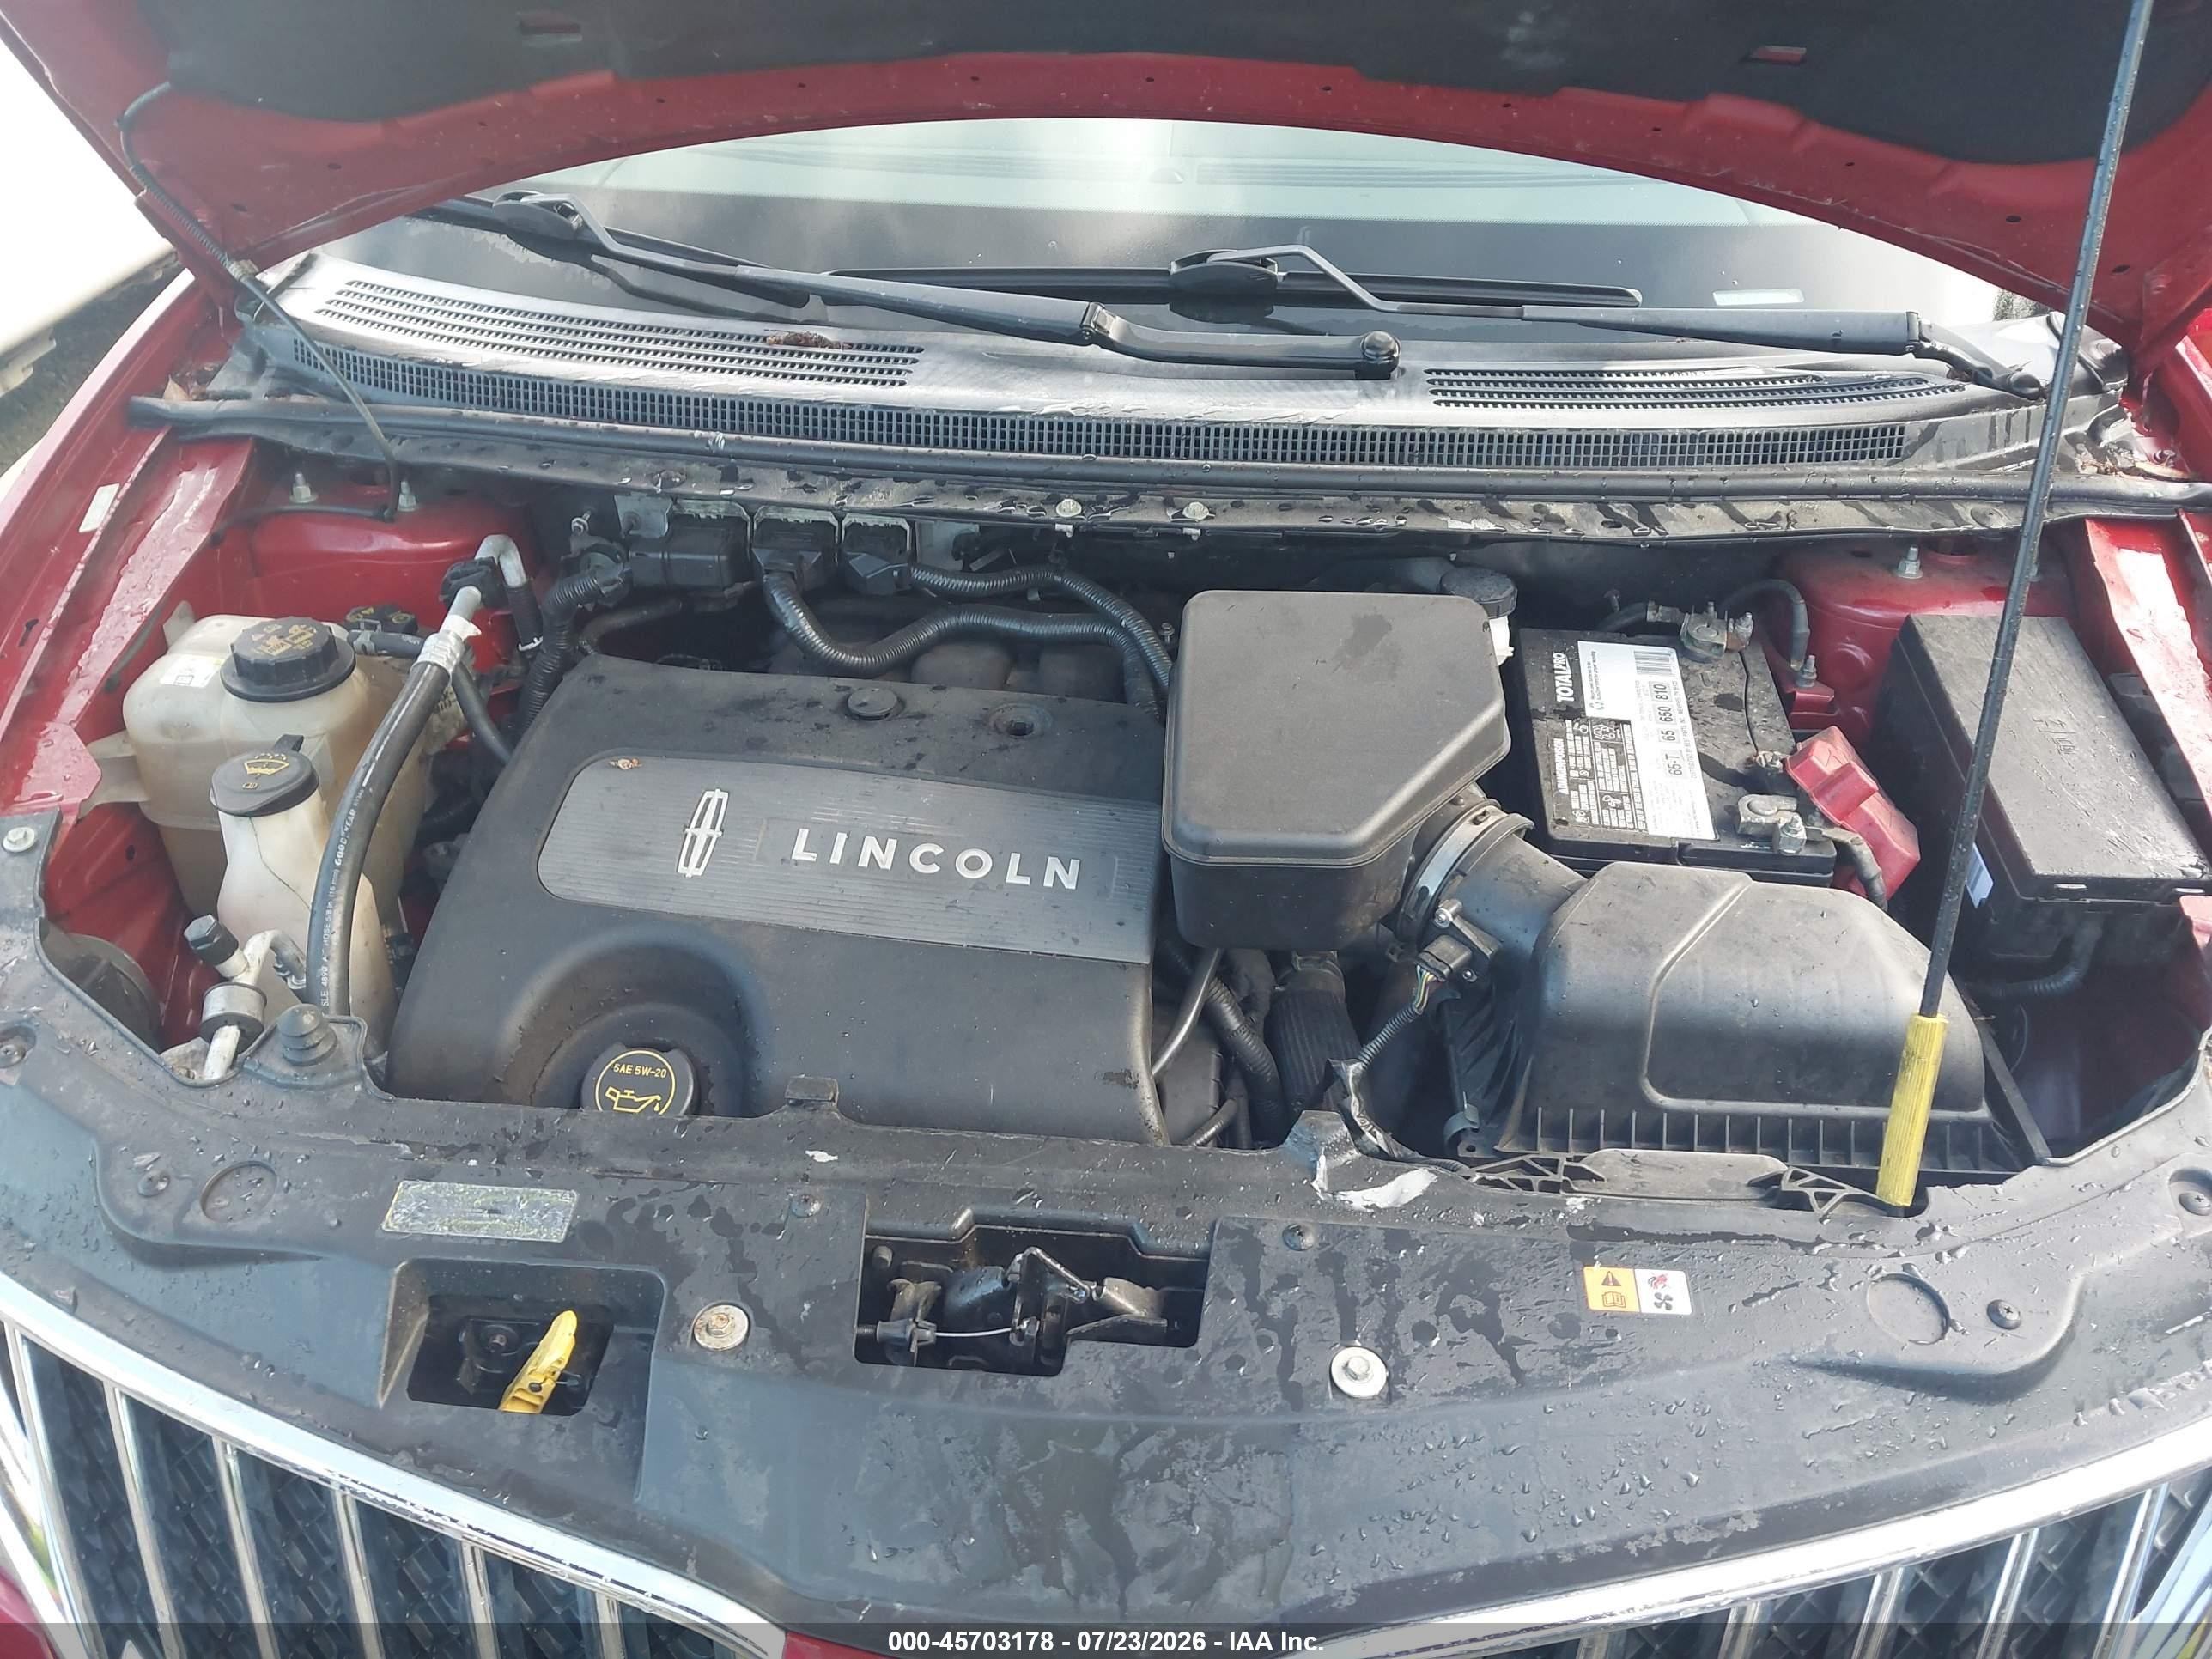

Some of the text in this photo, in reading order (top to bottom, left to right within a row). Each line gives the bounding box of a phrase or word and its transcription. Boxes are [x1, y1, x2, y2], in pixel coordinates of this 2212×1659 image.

[1553, 652, 1575, 702] TOTALPRO
[1653, 684, 1682, 775] 65-T 65 650 810
[791, 828, 1081, 890] LINCOLN
[613, 1063, 667, 1079] SAE 5W-20
